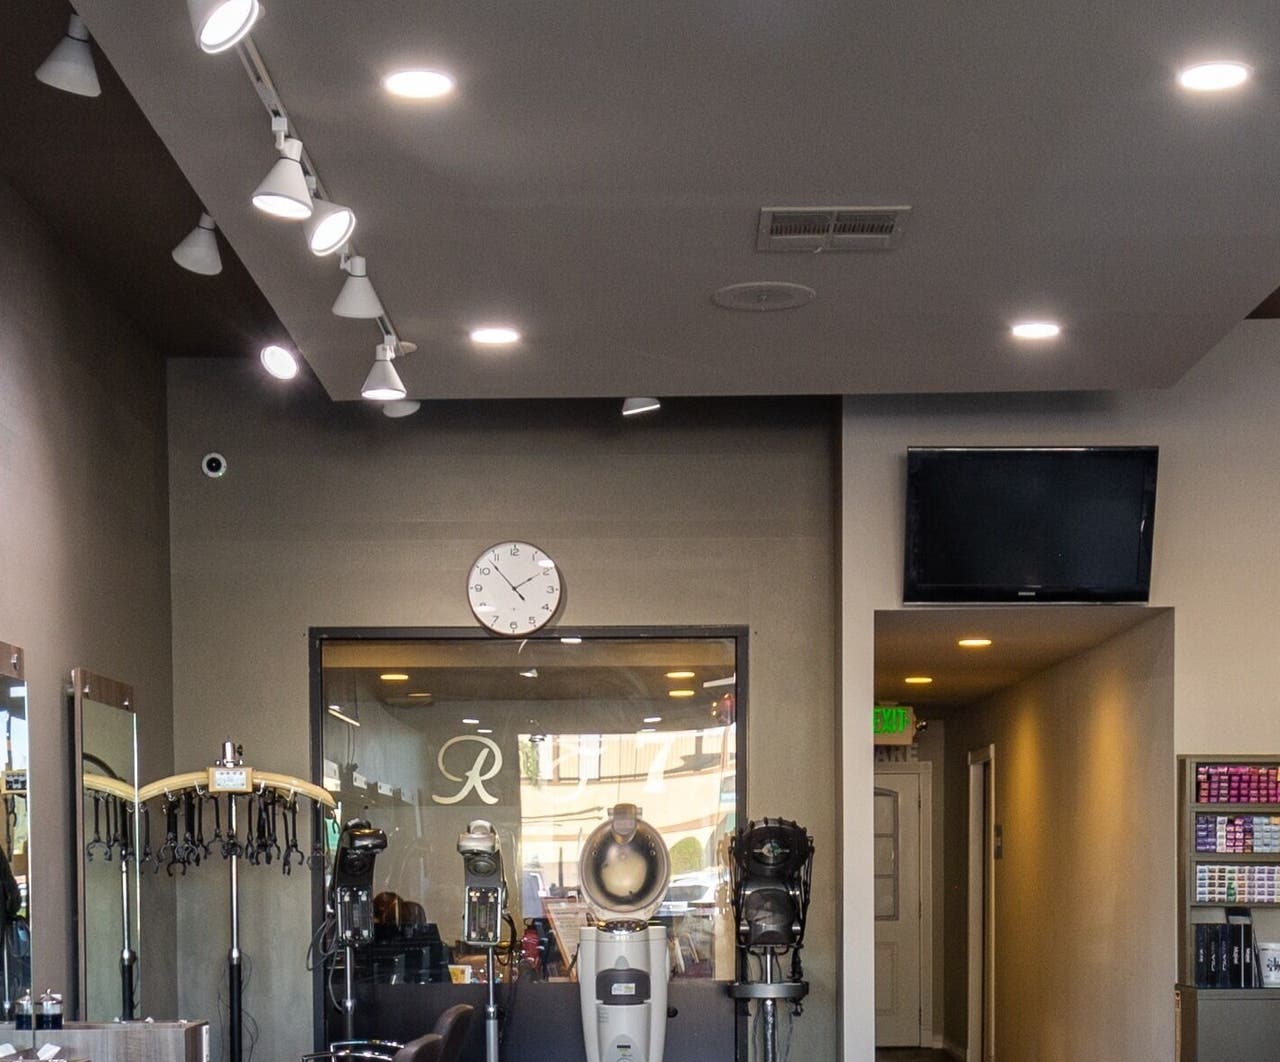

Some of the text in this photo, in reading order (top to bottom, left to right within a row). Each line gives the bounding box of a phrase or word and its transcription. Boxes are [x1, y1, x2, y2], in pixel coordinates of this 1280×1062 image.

[510, 548, 520, 556] 12
[494, 553, 499, 561] 11
[479, 567, 491, 576] 10
[542, 567, 550, 576] 2
[474, 584, 483, 592] 9
[546, 585, 554, 594] 3
[541, 603, 549, 611] 4
[492, 615, 499, 623] 7
[528, 616, 536, 625] 5
[509, 621, 518, 629] 6
[873, 707, 906, 733] EXIT
[431, 735, 503, 805] R
